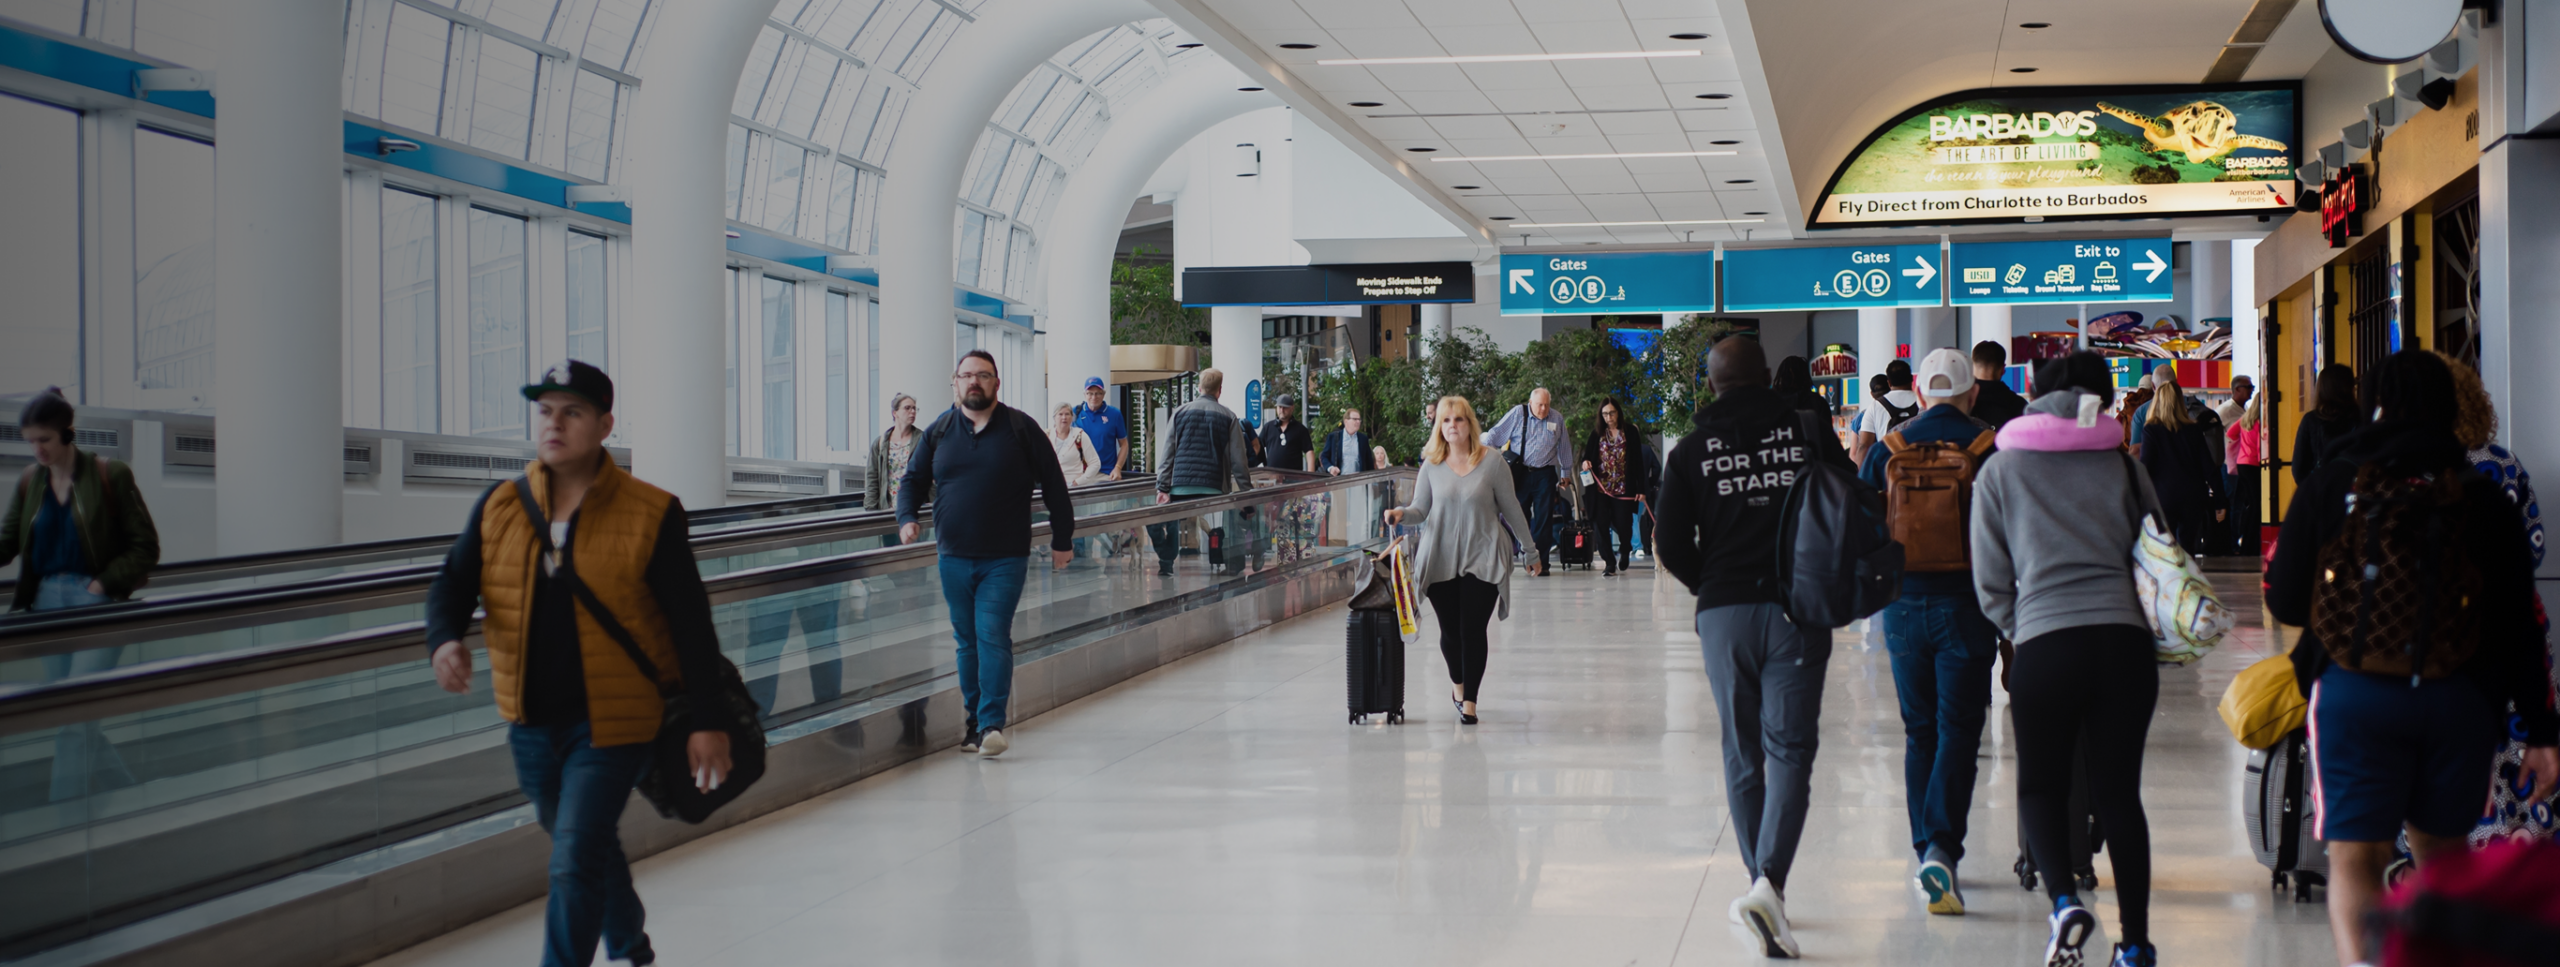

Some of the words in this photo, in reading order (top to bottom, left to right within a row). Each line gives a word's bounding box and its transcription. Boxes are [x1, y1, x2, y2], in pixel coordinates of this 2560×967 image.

[1929, 111, 2098, 142] BARBADOS
[1946, 148, 1971, 163] THE
[1980, 146, 2006, 162] ART
[2014, 145, 2030, 161] OF
[2039, 144, 2088, 160] LIVING
[2225, 156, 2289, 169] BARBADOS
[1999, 170, 2026, 183] your
[2026, 163, 2104, 183] playground
[2226, 168, 2290, 176] visitbarbados.org
[2229, 189, 2266, 197] American
[2236, 196, 2266, 204] Airlines
[1839, 200, 1863, 217] Fly
[1867, 199, 1918, 213] Direct
[1921, 197, 1961, 211] from
[1964, 195, 2042, 210] Charlotte
[2046, 194, 2064, 207] to
[2067, 191, 2149, 207] Barbados
[1851, 250, 1891, 264] Gates
[2075, 244, 2102, 258] Exit
[2105, 245, 2121, 258] to
[1549, 257, 1588, 271] Gates
[1357, 277, 1386, 287] Moving
[1387, 276, 1422, 285] Sidewalk
[1423, 276, 1442, 285] Ends
[1842, 275, 1852, 290] E
[1871, 274, 1885, 289] D
[1970, 270, 1990, 280] USO
[1363, 287, 1394, 297] Prepare
[1394, 286, 1404, 295] to
[1404, 286, 1422, 296] Step
[1423, 286, 1436, 294] Off
[1557, 281, 1570, 296] A
[1587, 281, 1598, 295] B
[1969, 286, 1991, 295] Lounge
[2002, 285, 2030, 295] Ticketing
[2035, 284, 2056, 293] Ground
[2057, 284, 2085, 293] Transport
[2091, 283, 2103, 293] Bag
[2103, 283, 2121, 292] Claim
[1811, 356, 1831, 377] PAPA
[1701, 454, 1751, 477] FOR
[1757, 447, 1804, 465] THE
[1717, 470, 1795, 496] STARS
